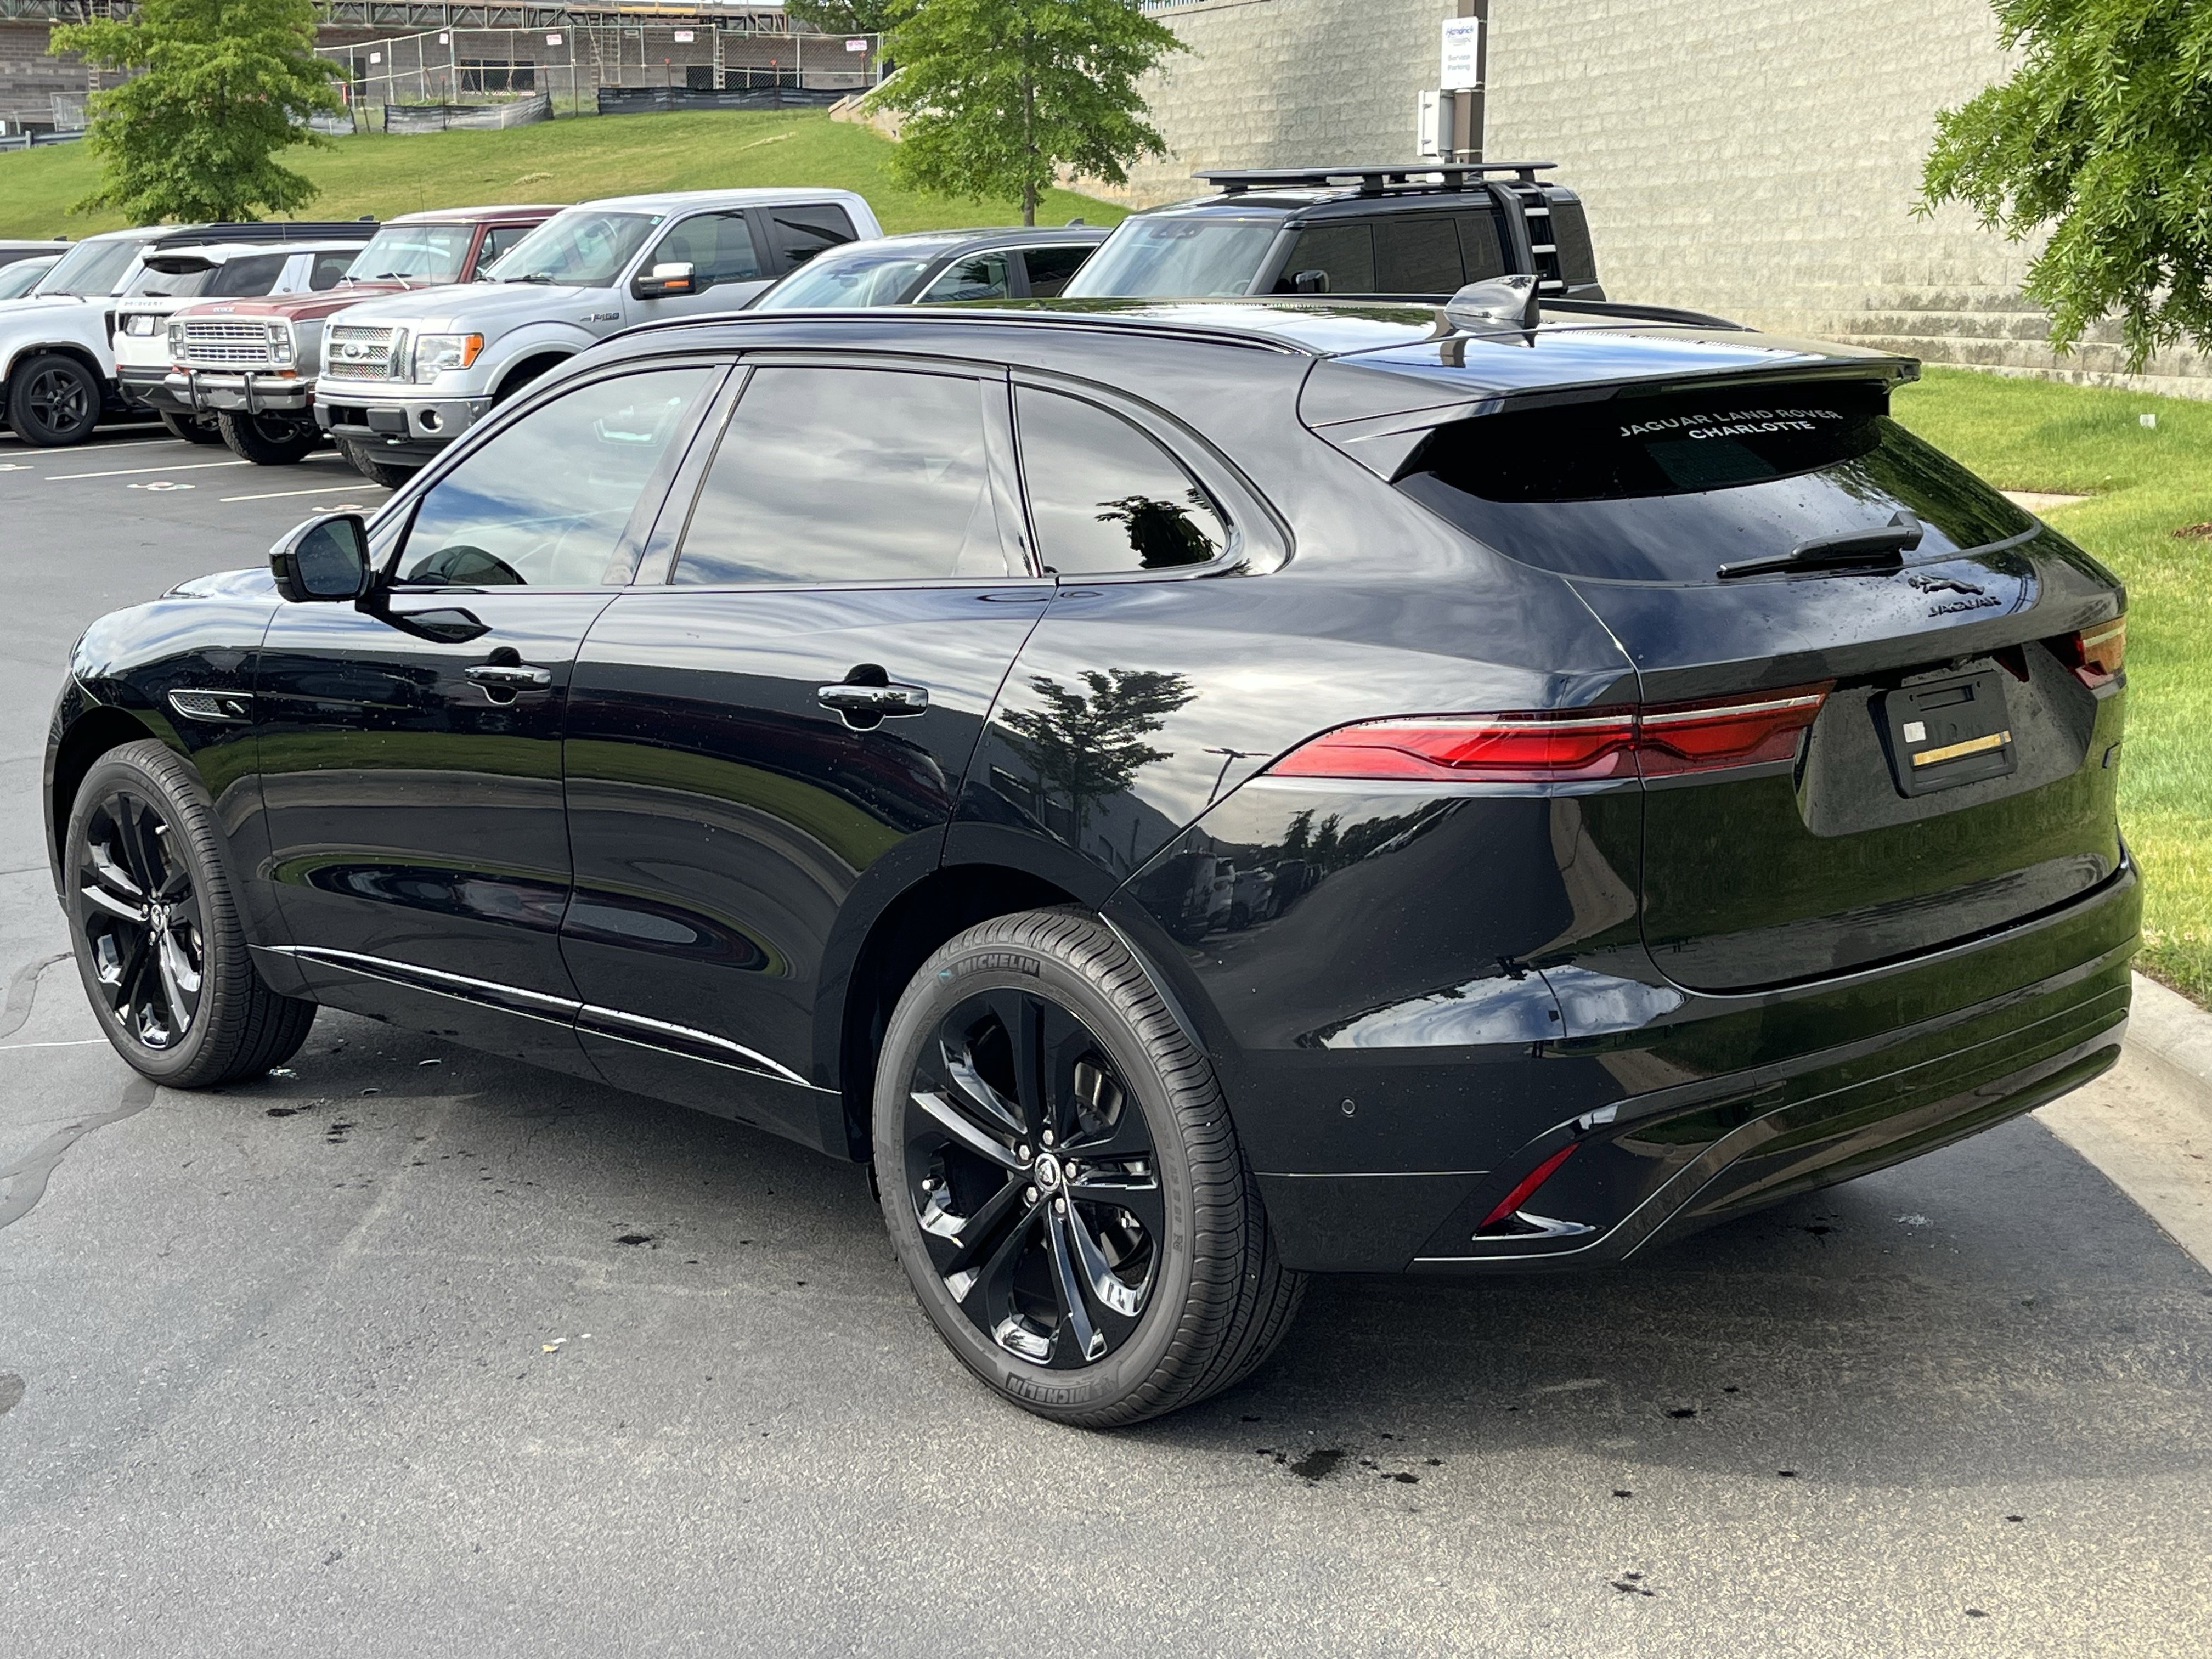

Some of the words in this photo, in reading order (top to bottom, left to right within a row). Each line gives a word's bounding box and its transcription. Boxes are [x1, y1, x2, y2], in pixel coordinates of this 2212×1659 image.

[1446, 26, 1474, 37] Hendrick
[1619, 414, 1708, 437] JAGUAR
[1713, 410, 1774, 422] LAND
[1775, 409, 1844, 420] ROVER
[1688, 420, 1816, 440] CHARLOTTE
[1928, 596, 2002, 618] JAGUAR
[957, 953, 1040, 976] MICHELIN
[1007, 1376, 1091, 1404] MICHELIN
